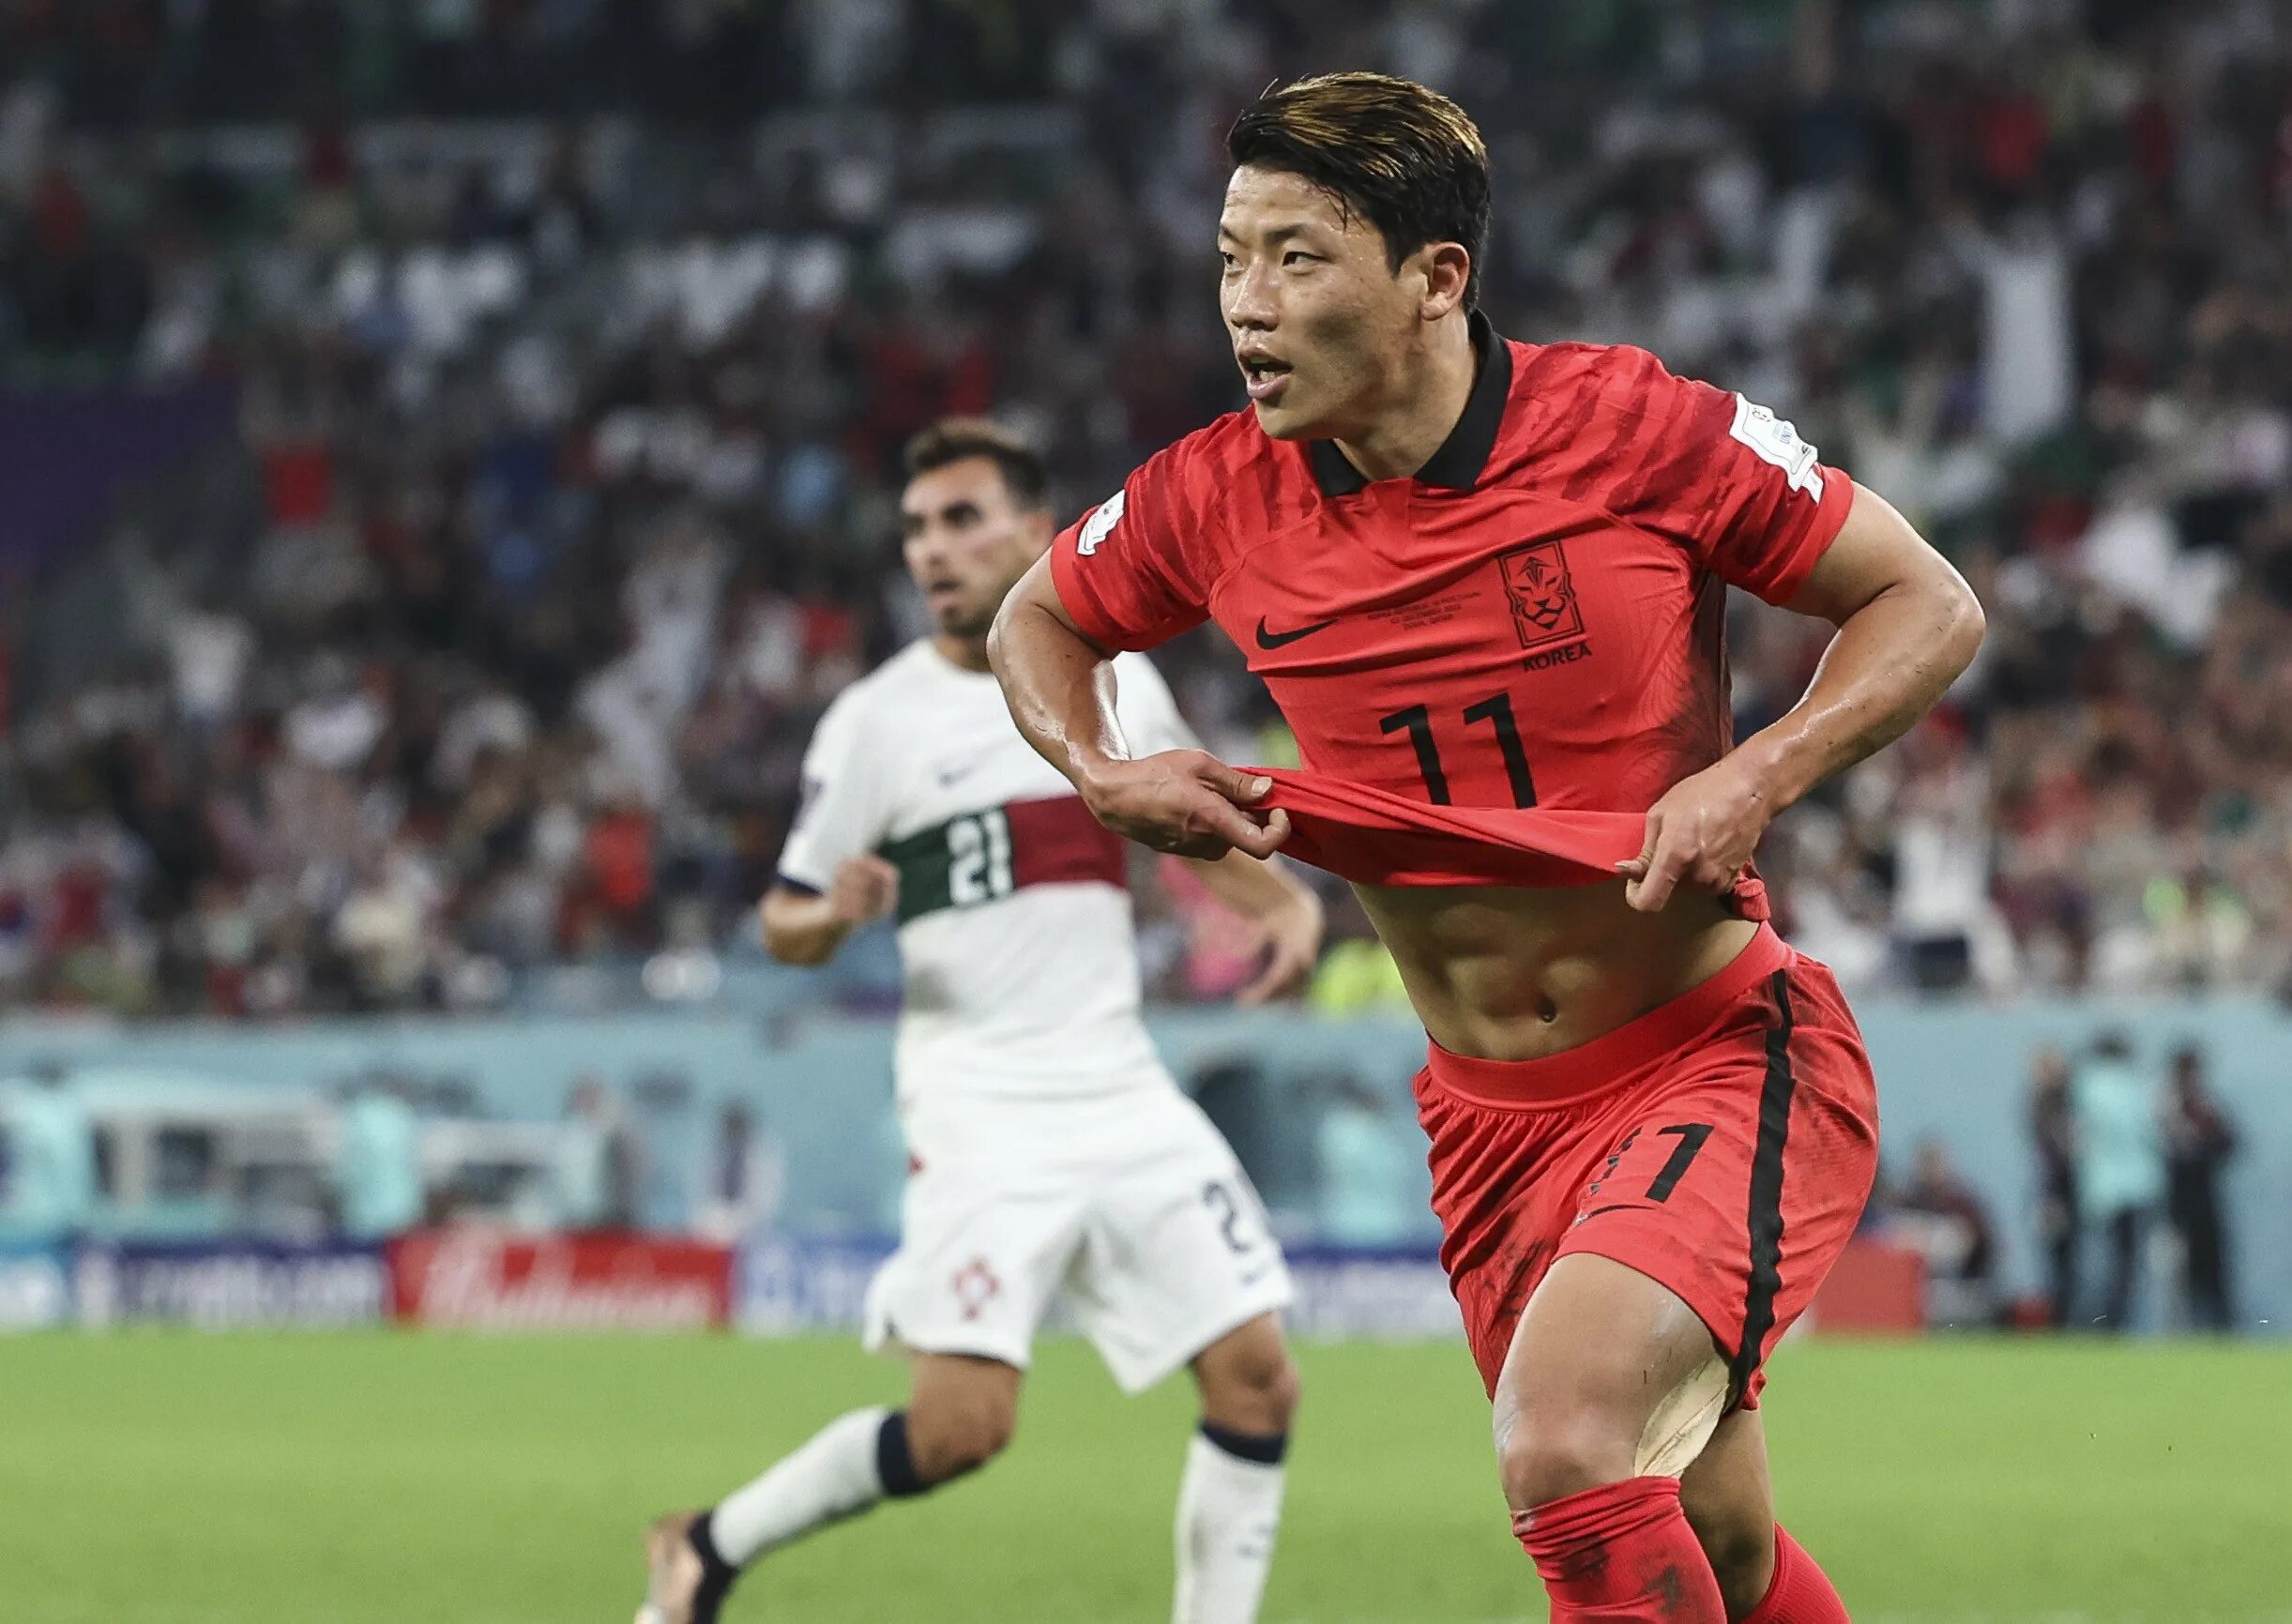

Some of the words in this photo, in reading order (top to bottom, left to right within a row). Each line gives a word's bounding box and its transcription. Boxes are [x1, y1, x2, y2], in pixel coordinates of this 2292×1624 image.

[1522, 642, 1592, 672] KOREA
[1379, 691, 1538, 810] 11
[947, 811, 1014, 904] 21
